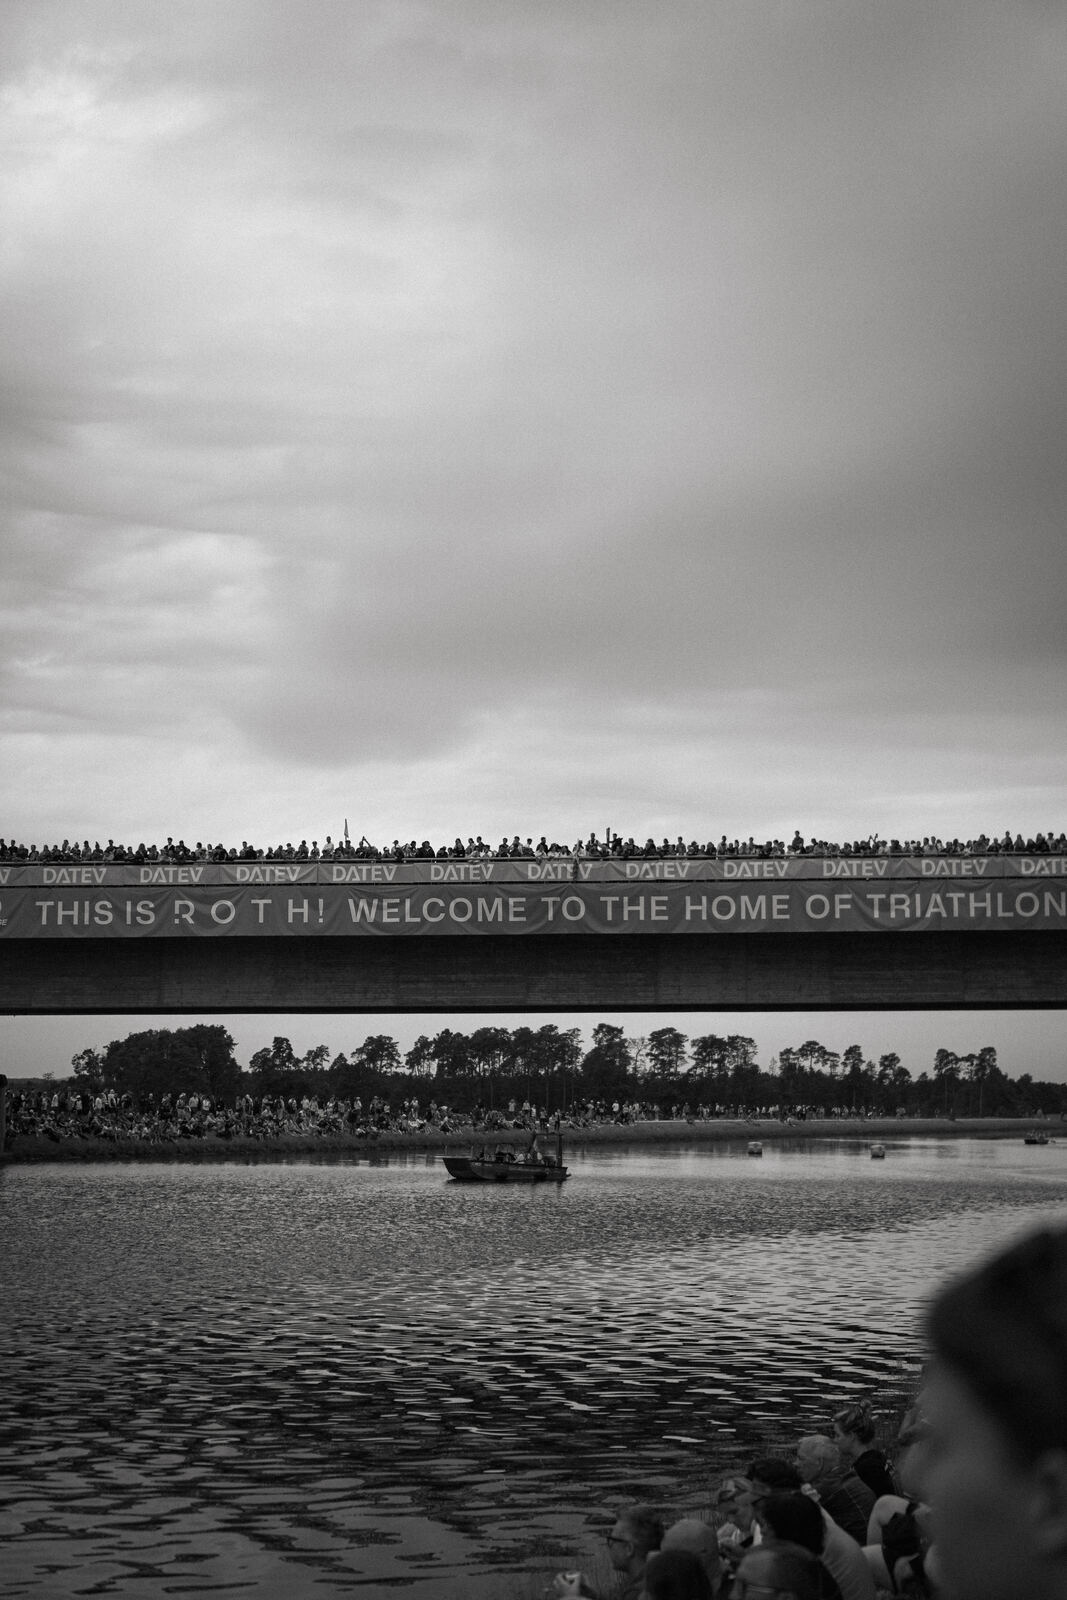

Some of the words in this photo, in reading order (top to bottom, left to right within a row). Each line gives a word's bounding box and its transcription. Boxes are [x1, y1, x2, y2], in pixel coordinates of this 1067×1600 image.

[43, 867, 107, 884] DATEV
[140, 867, 203, 883] DATEV
[236, 866, 301, 882] DATEV
[332, 865, 396, 882] DATEV
[430, 864, 494, 881] DATEV
[527, 863, 593, 880] DATEV
[626, 862, 690, 879] DATEV
[723, 861, 789, 878] DATEV
[823, 860, 888, 877] DATEV
[921, 859, 987, 876] DATEV
[35, 901, 113, 925] THIS
[126, 901, 155, 925] IS
[348, 897, 527, 923] WELCOME
[541, 896, 586, 921] TO
[600, 896, 669, 921] THE
[685, 895, 790, 920] HOME
[805, 894, 852, 919] OF
[866, 892, 1067, 918] TRIATHLON
